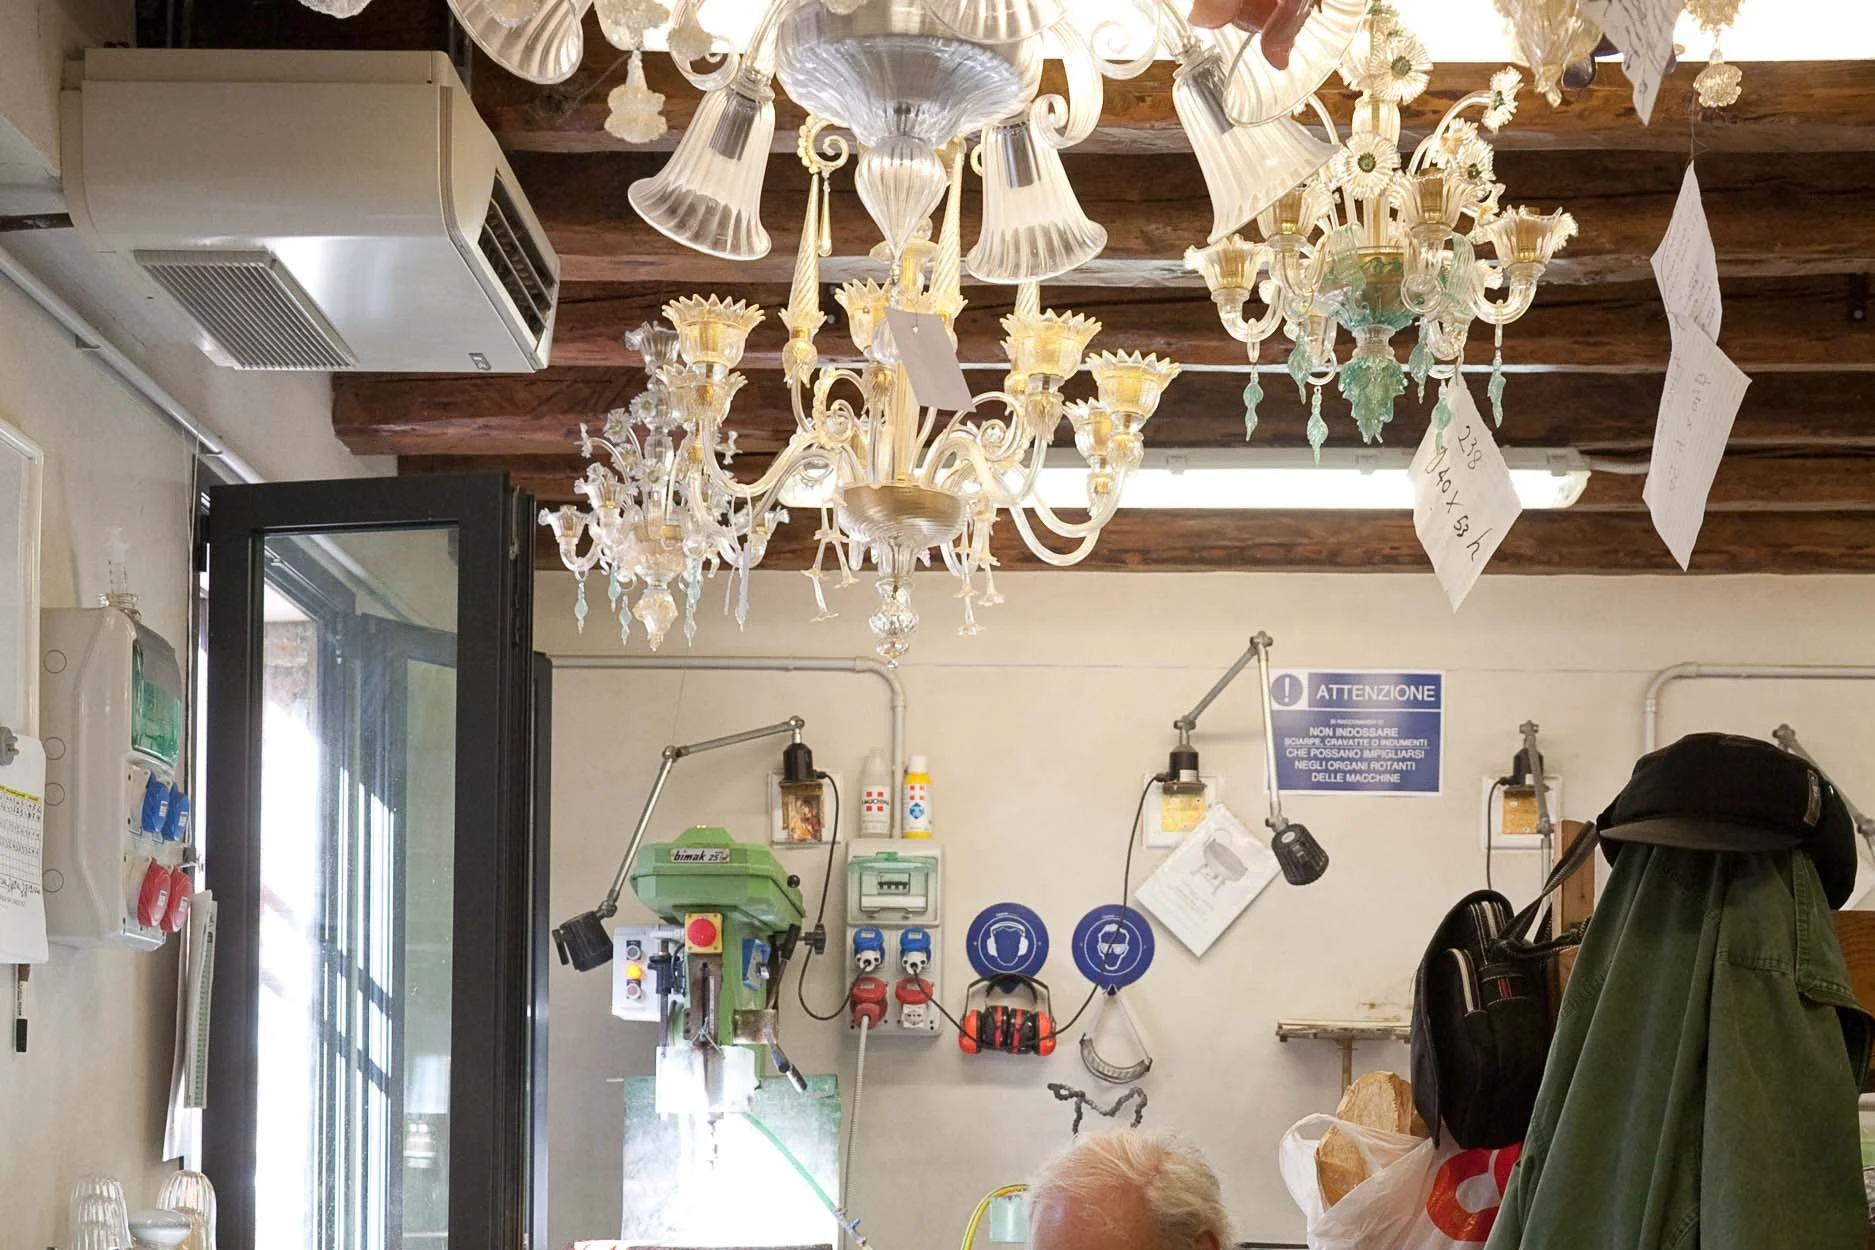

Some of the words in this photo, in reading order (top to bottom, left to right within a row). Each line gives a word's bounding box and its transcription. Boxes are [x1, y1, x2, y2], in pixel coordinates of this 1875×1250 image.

[1457, 425, 1482, 470] 238
[1315, 684, 1436, 701] ATTENZIONE
[1309, 727, 1333, 737] NON
[1336, 727, 1398, 737] INDOSSARE
[1325, 738, 1370, 746] CRAVATTE
[1381, 739, 1428, 747] INDUMENTI
[1286, 749, 1309, 758] CHE
[1311, 749, 1361, 758] POSSANO
[1363, 750, 1425, 759] IMPIGLIARSI
[1294, 760, 1326, 770] NEGLI
[1328, 761, 1368, 770] ORGANI
[1371, 761, 1416, 771] ROTANTI
[1311, 773, 1344, 783] DELLE
[1346, 774, 1401, 783] MACCHINE
[673, 850, 705, 861] bimak
